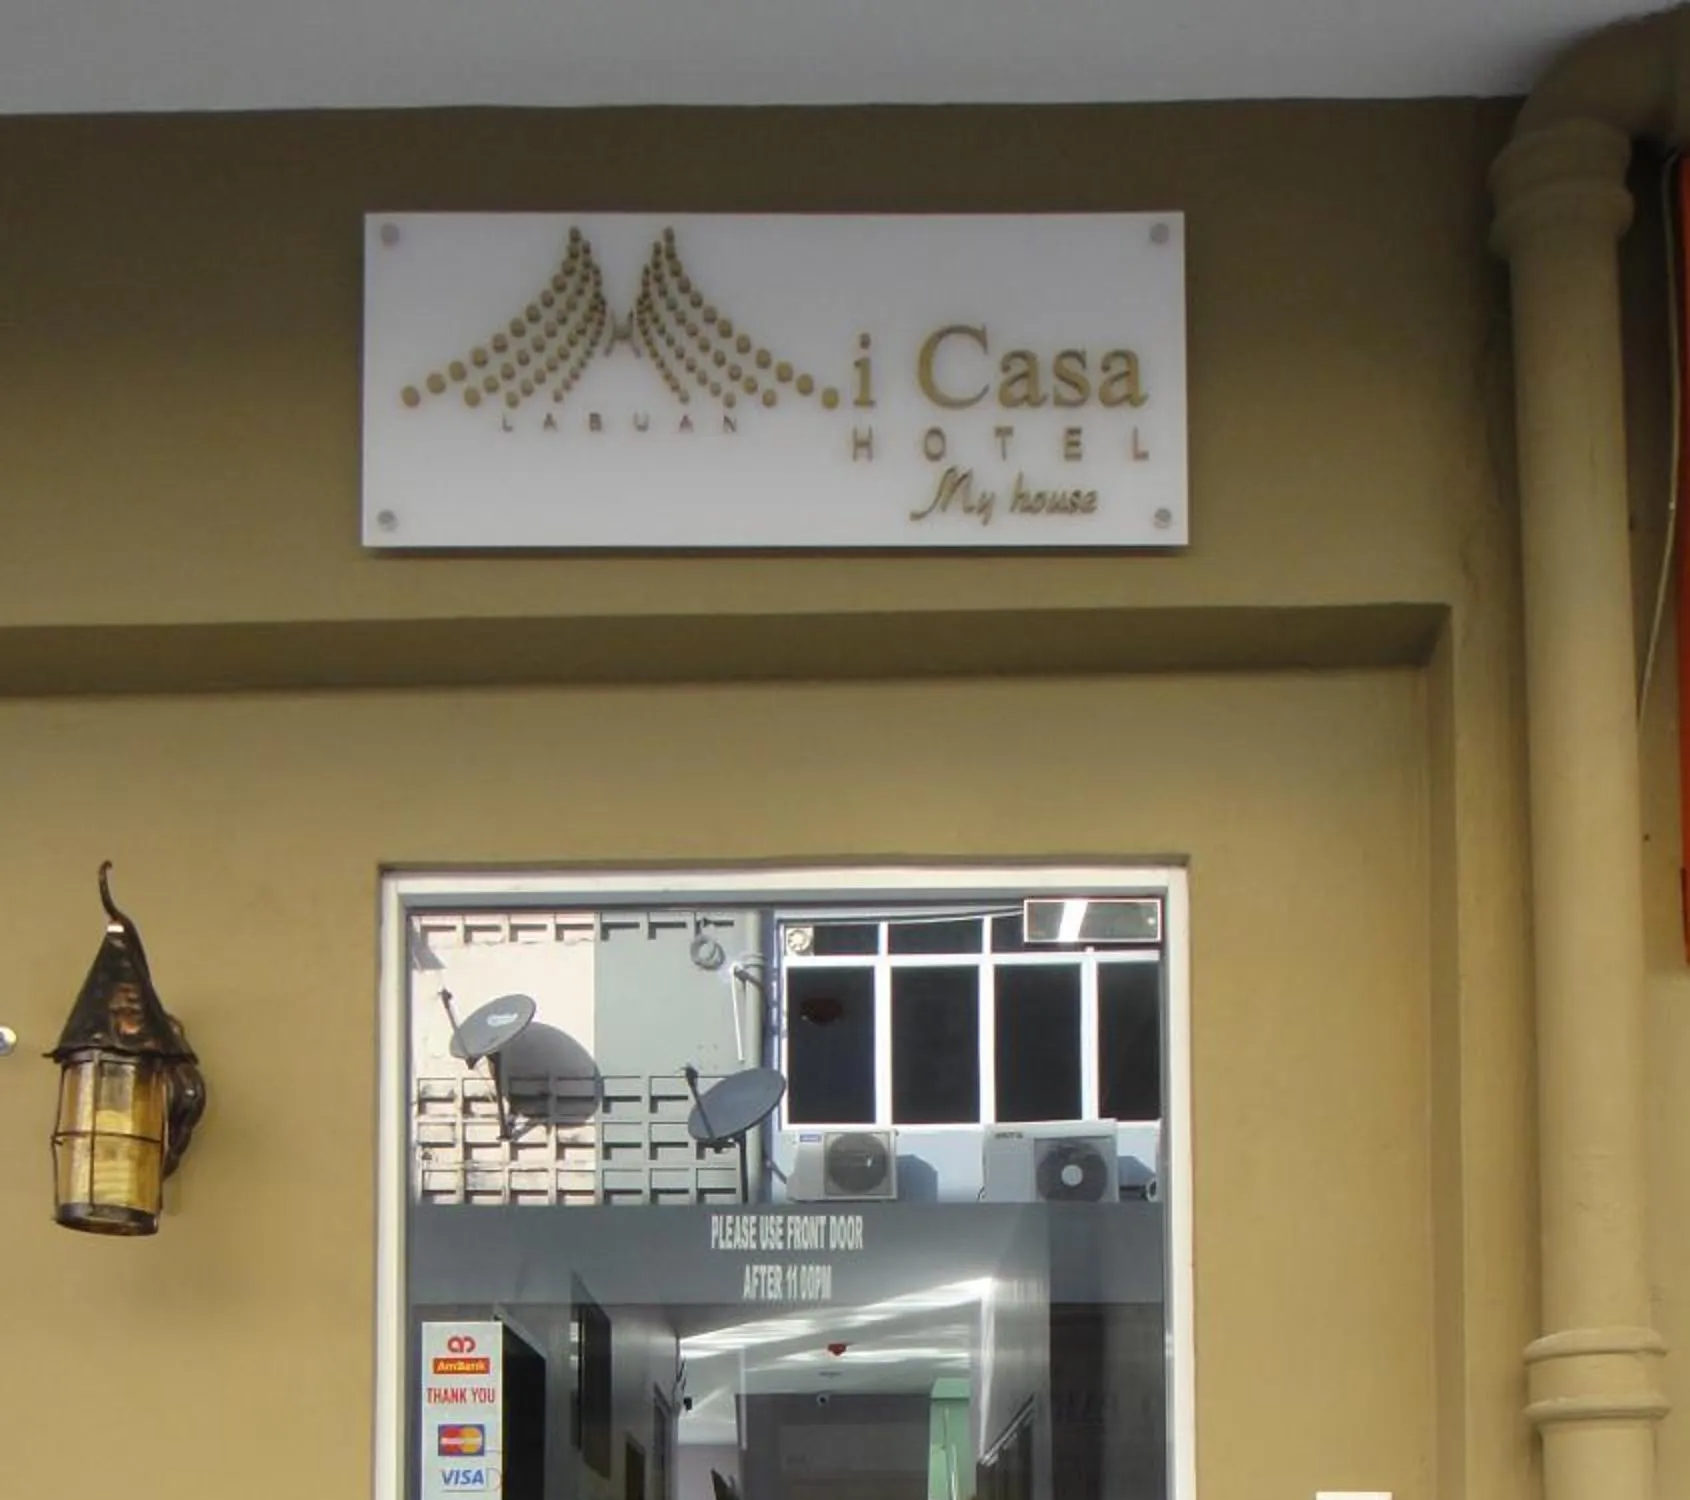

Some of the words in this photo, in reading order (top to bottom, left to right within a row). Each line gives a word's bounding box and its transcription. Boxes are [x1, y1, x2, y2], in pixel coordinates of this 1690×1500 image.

[917, 324, 1149, 409] Casa
[501, 412, 738, 433] LABUAN
[851, 425, 1149, 462] HOTEL
[909, 466, 996, 527] My
[1009, 470, 1098, 515] house
[711, 1215, 757, 1249] PLEASE
[759, 1215, 784, 1249] USE
[787, 1215, 827, 1249] FRONT
[829, 1215, 863, 1249] DOOR
[743, 1264, 783, 1299] AFTER
[435, 1360, 487, 1372] AmBank
[427, 1387, 467, 1404] THANK
[471, 1387, 496, 1404] YOU
[440, 1469, 485, 1485] VISA
